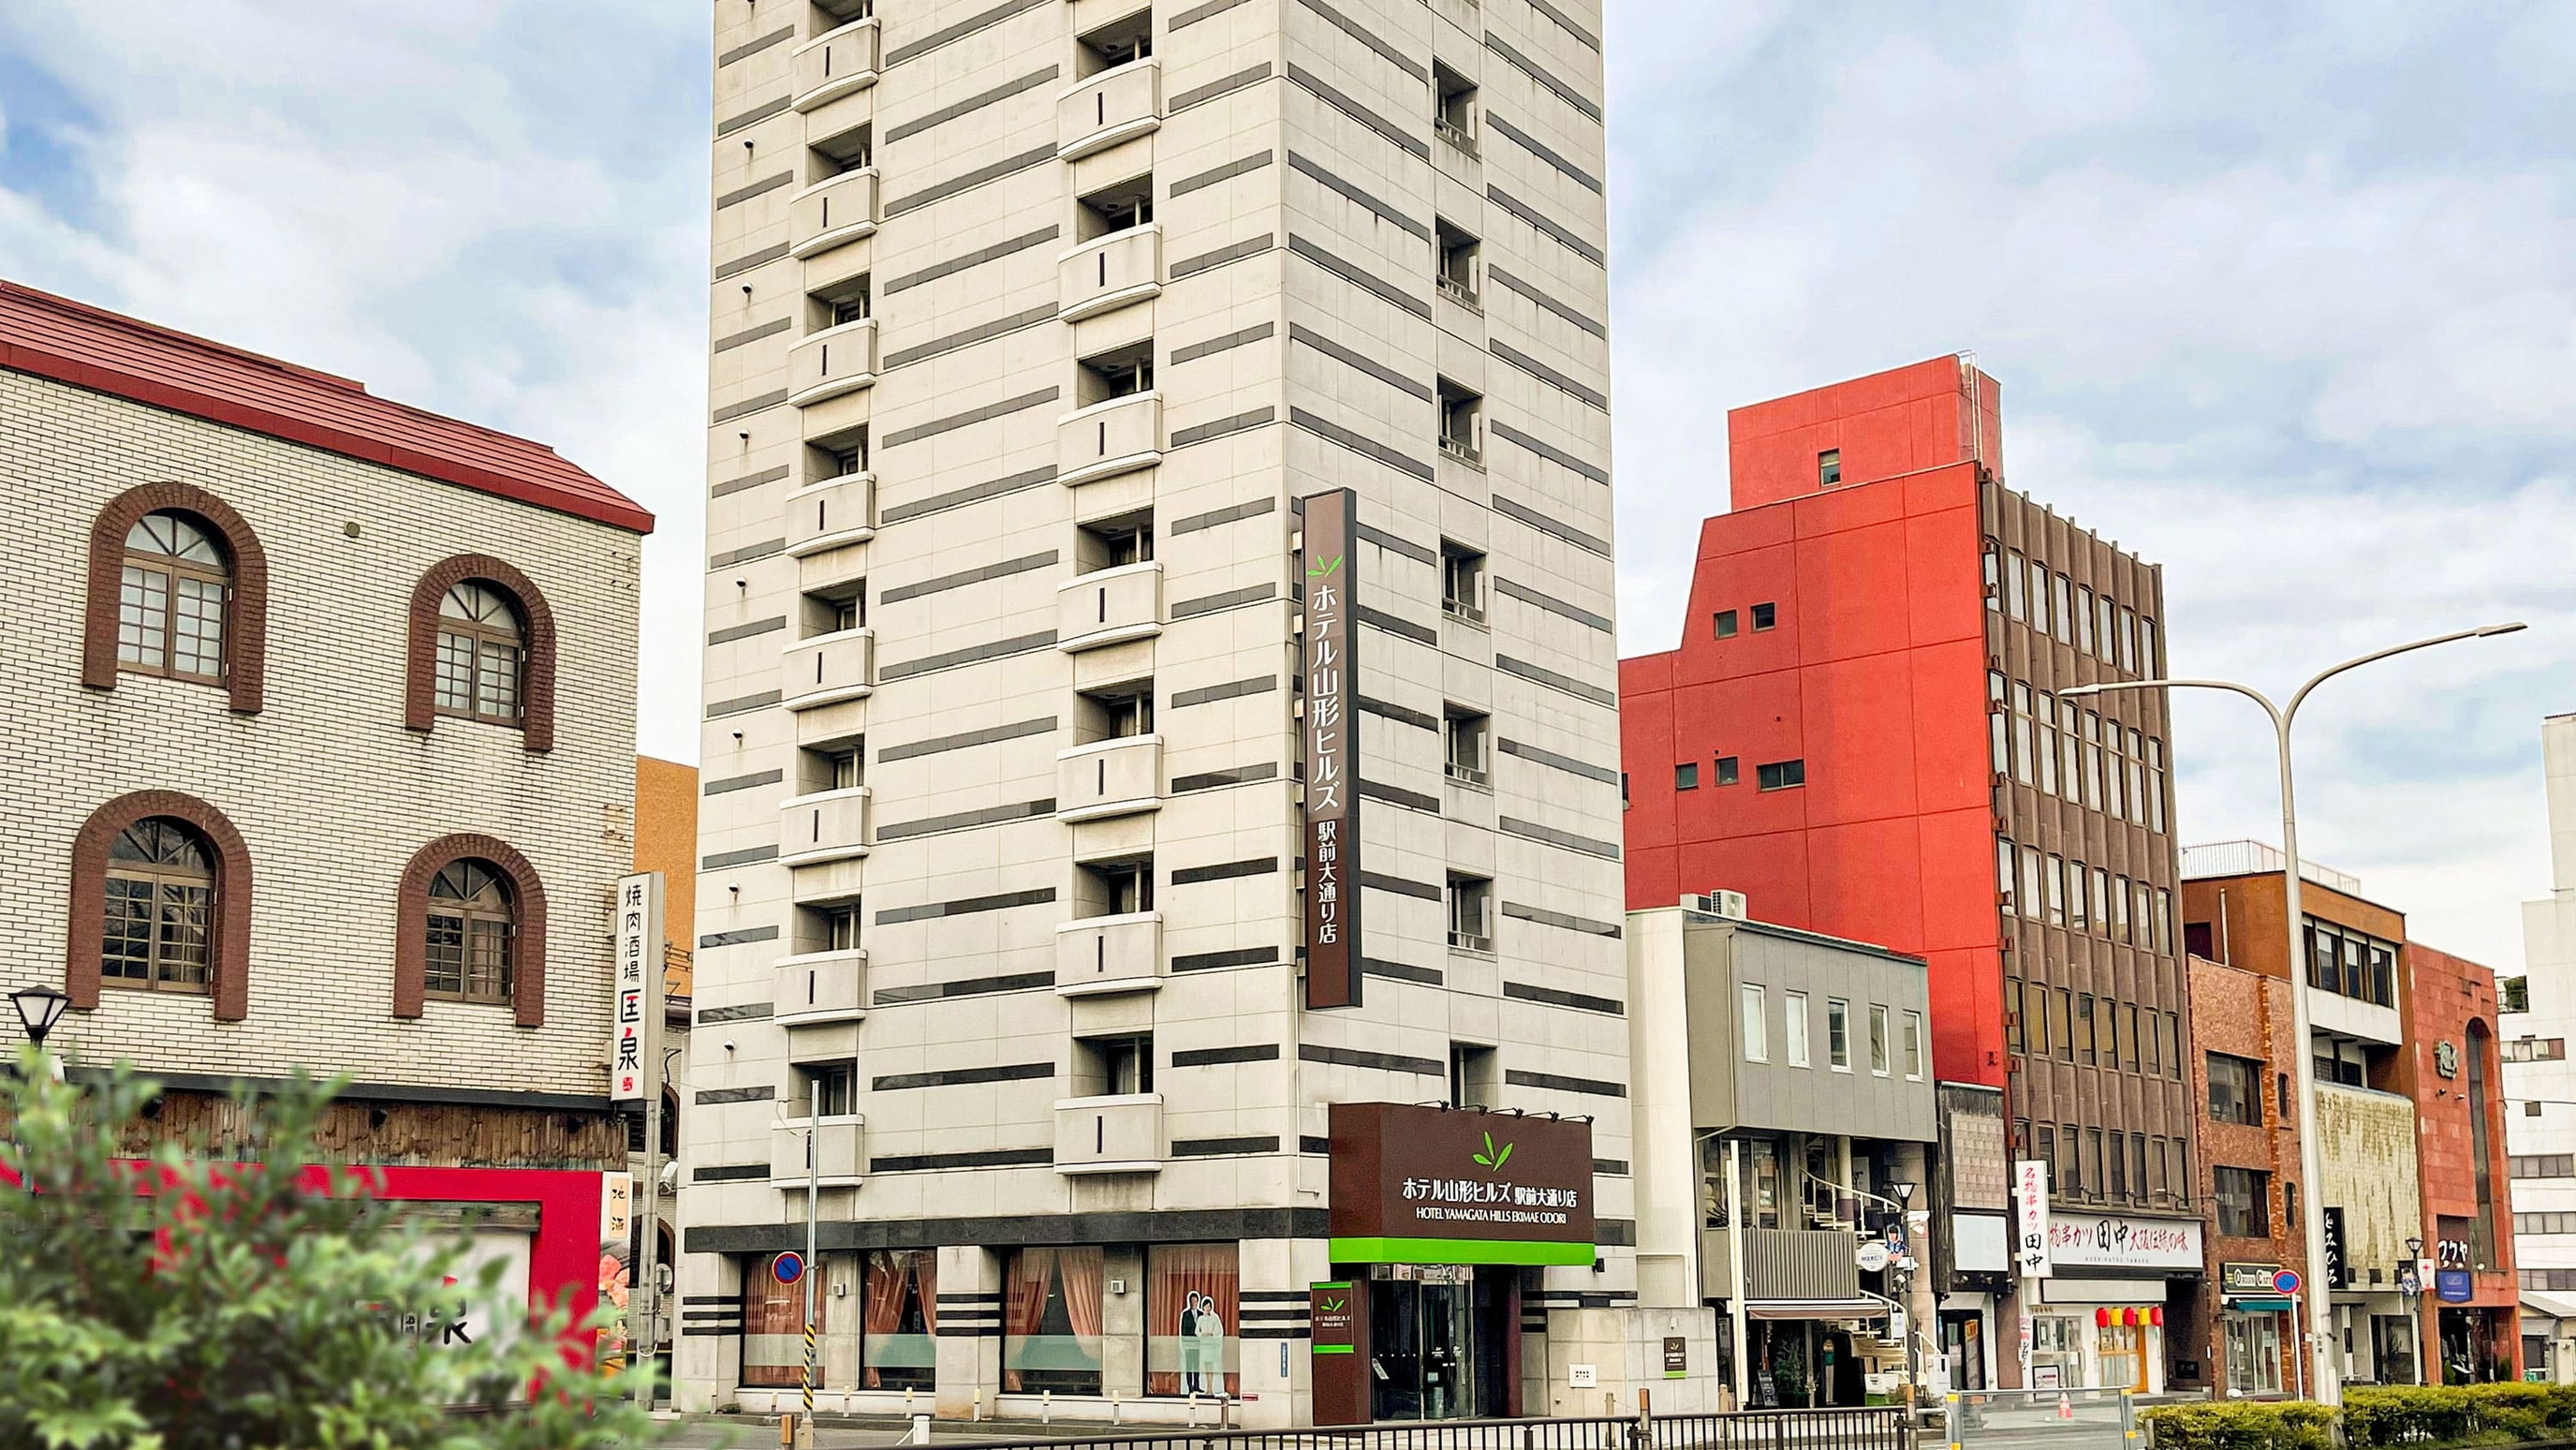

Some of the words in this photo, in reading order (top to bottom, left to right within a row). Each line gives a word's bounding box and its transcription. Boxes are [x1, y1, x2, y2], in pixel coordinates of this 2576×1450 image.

[1312, 584, 1339, 811] ホテル山形ヒルズ
[1317, 820, 1337, 945] 駅前大通り店
[625, 884, 641, 984] 焼肉酒場
[618, 988, 641, 1071] 匡泉
[1402, 1176, 1511, 1204] ホテル山形ヒルズ
[1514, 1187, 1578, 1208] 駅前大通り店
[1416, 1206, 1444, 1220] HOTEL
[1444, 1207, 1489, 1221] YAMAGATA
[1490, 1209, 1511, 1222] HILLS
[1511, 1210, 1539, 1223] EKIMAE
[1539, 1212, 1567, 1224] ODORI
[2024, 1167, 2038, 1232] 名物串カツ
[2025, 1234, 2043, 1272] 田中
[2097, 1220, 2128, 1254] 田中
[2325, 1212, 2338, 1284] とみひろ
[2437, 1239, 2468, 1262] フクヤ
